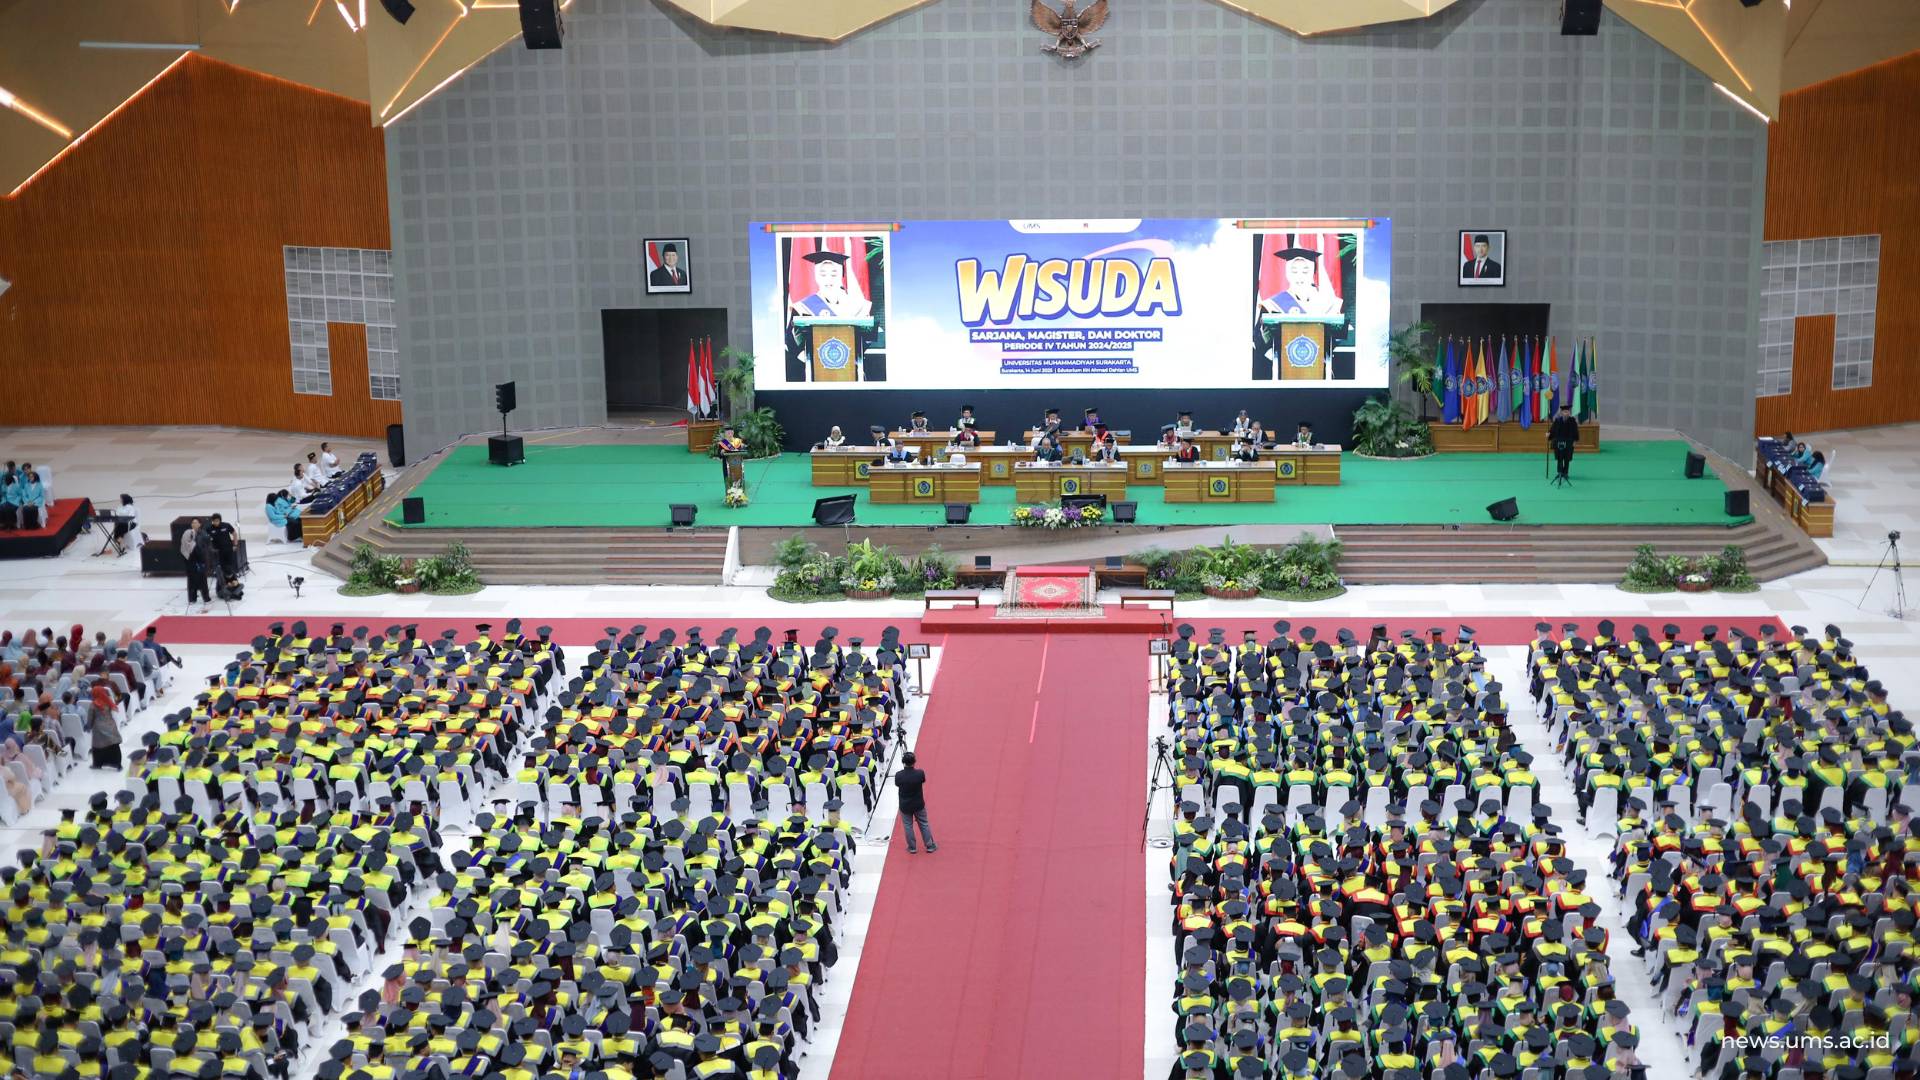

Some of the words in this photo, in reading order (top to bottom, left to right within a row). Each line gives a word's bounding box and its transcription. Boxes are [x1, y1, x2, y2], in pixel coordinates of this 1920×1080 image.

[956, 254, 1183, 327] WISUDA
[972, 331, 1025, 341] SARJANA,
[1027, 330, 1085, 340] MAGISTER,
[1088, 330, 1112, 339] DAN
[1115, 330, 1160, 339] DOKTOR
[1004, 342, 1043, 350] PERIODE
[1046, 342, 1054, 350] IV
[1056, 342, 1086, 350] TAHUN
[1088, 341, 1132, 349] 2024/2025
